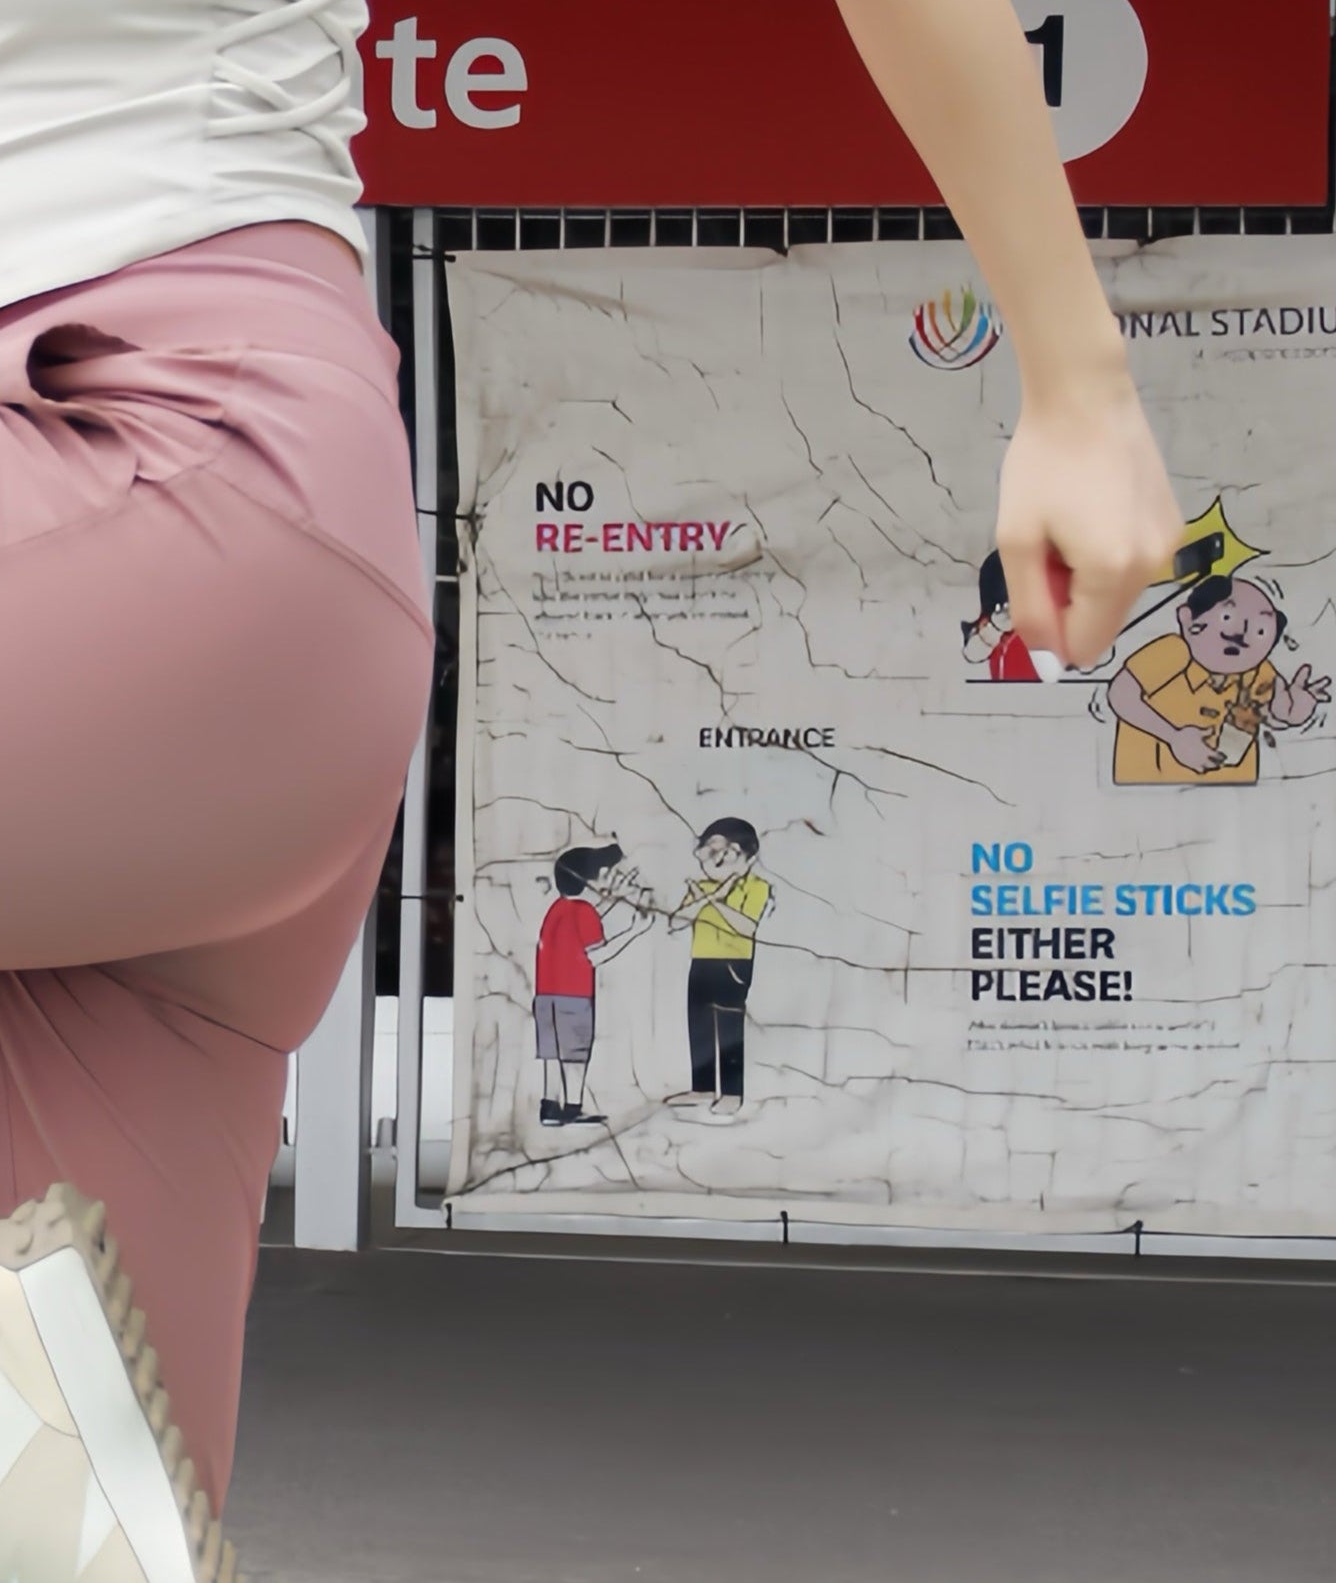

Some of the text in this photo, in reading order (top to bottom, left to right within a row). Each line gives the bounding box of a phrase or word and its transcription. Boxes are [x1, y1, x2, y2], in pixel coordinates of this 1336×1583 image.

[354, 16, 528, 130] te
[1024, 14, 1064, 108] 1
[535, 480, 594, 512] NO
[536, 521, 731, 553] RE-ENTRY
[699, 727, 836, 749] ENTRANCE
[971, 842, 1033, 874] NO
[971, 883, 1256, 916] SELFIE STICKS
[971, 927, 1115, 959] EITHER
[971, 970, 1133, 1002] PLEASE!
